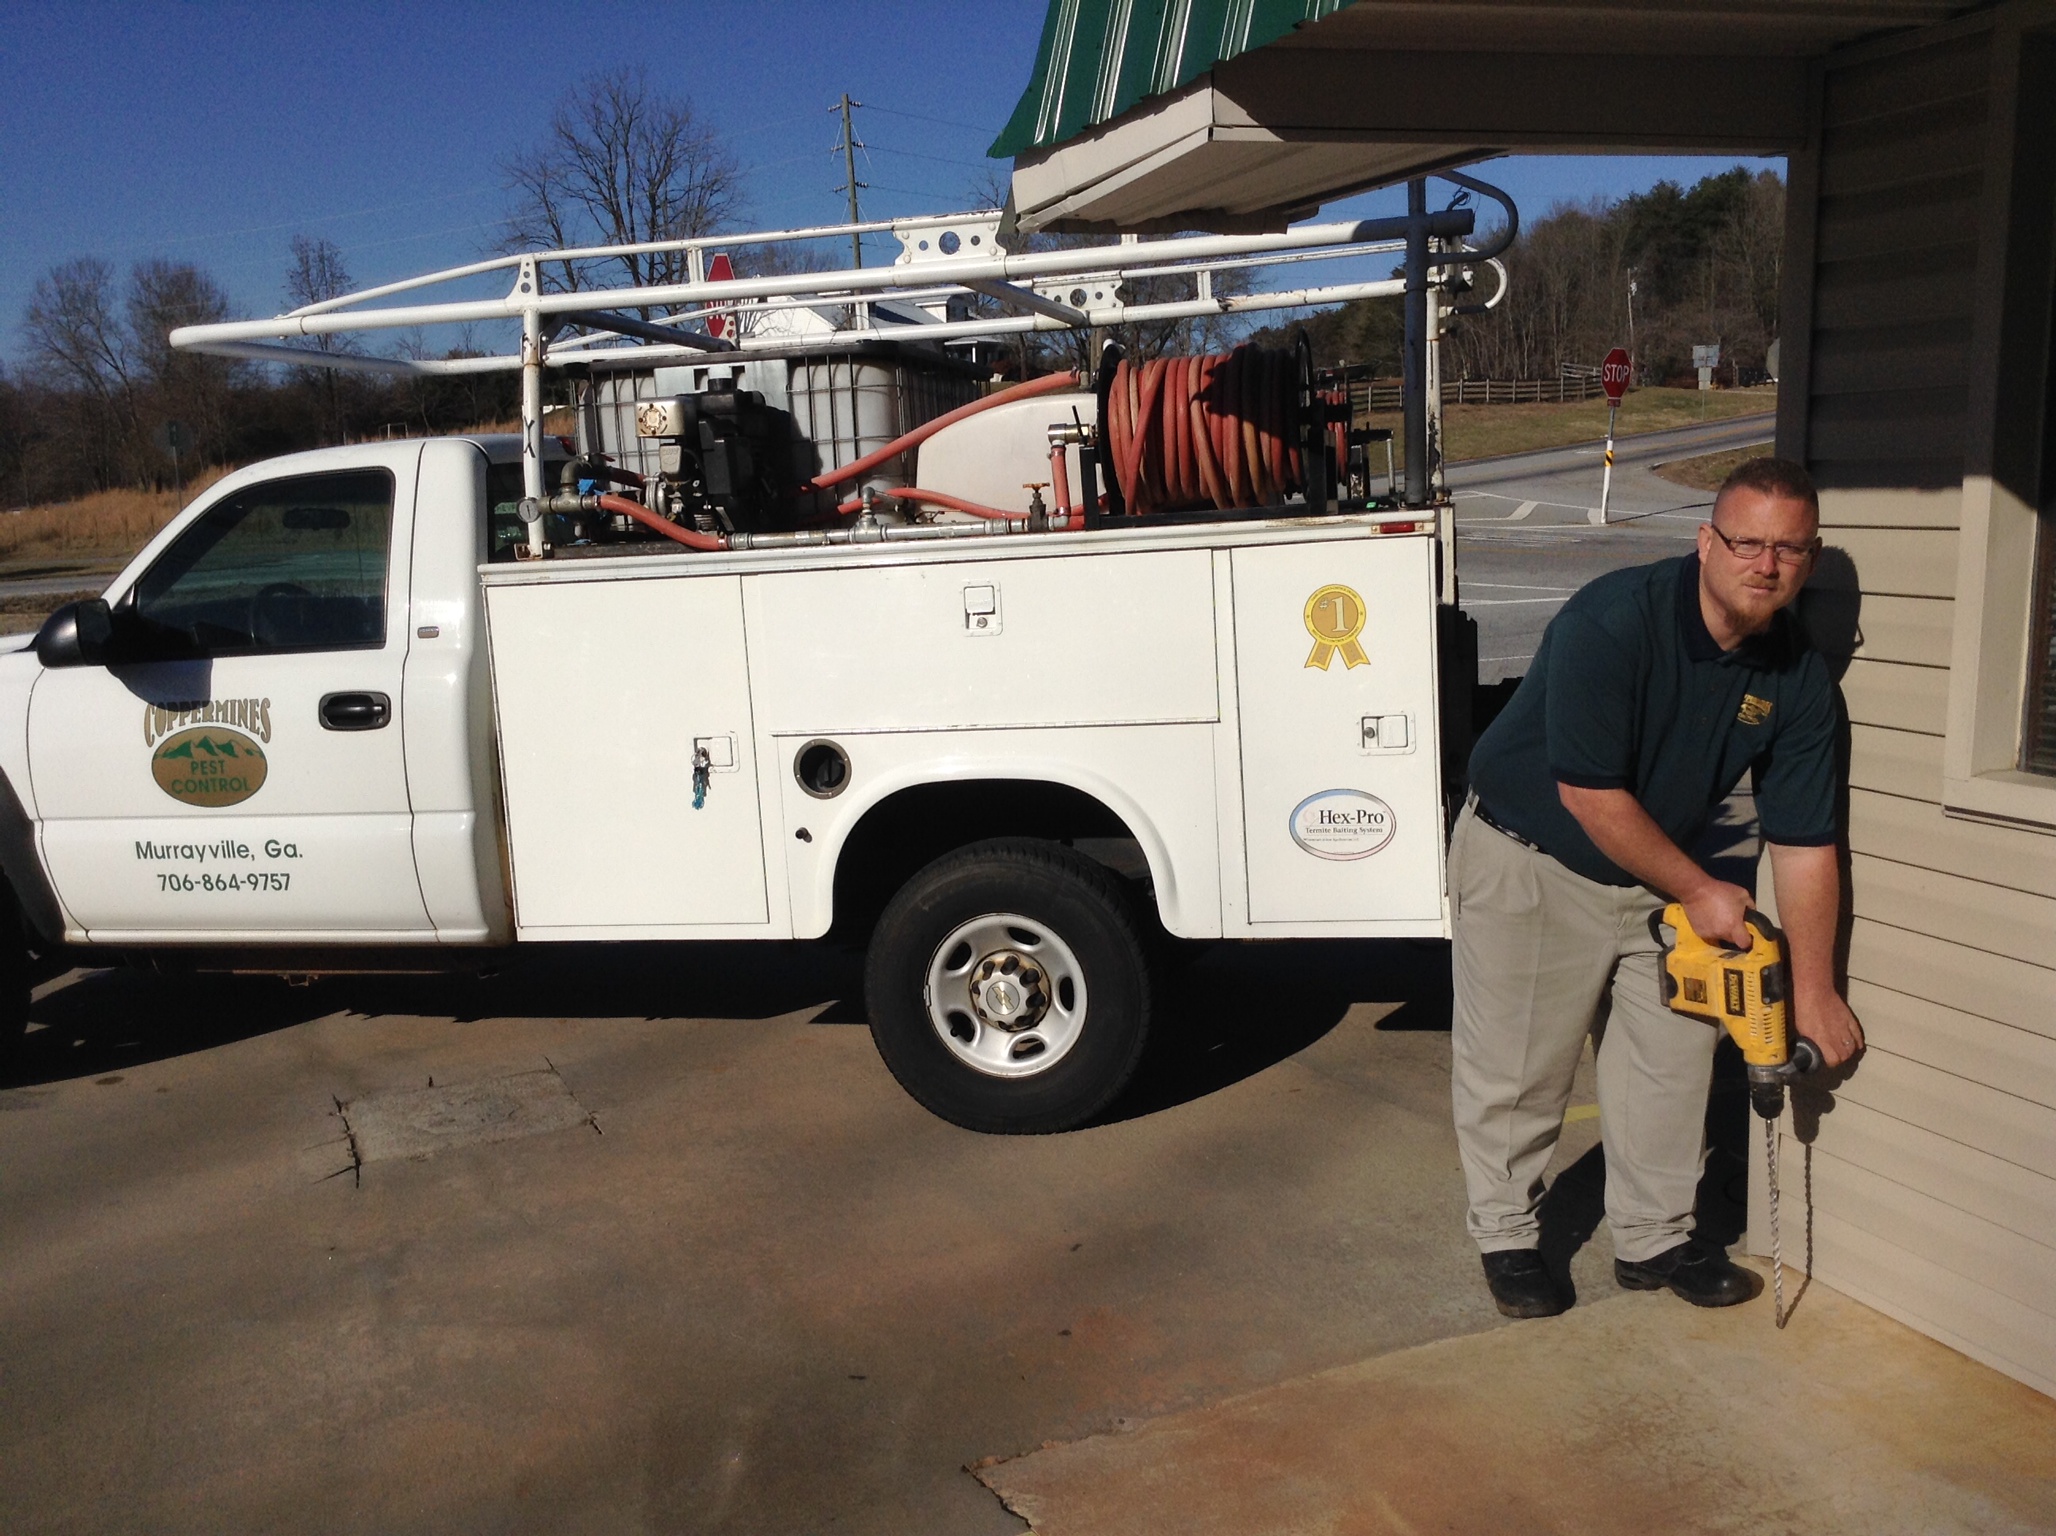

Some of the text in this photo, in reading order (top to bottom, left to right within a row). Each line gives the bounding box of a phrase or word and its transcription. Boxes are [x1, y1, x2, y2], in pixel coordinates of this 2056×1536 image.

[1603, 363, 1630, 383] STOP
[144, 697, 272, 748] COPPERMINES
[191, 760, 225, 775] PEST
[171, 777, 251, 795] CONTROL
[1319, 809, 1384, 825] Hex-Pro
[1333, 827, 1358, 835] Baiting
[1359, 826, 1383, 835] System
[135, 839, 303, 863] Murrayville, Ga.
[157, 873, 290, 892] 706-864-9757
